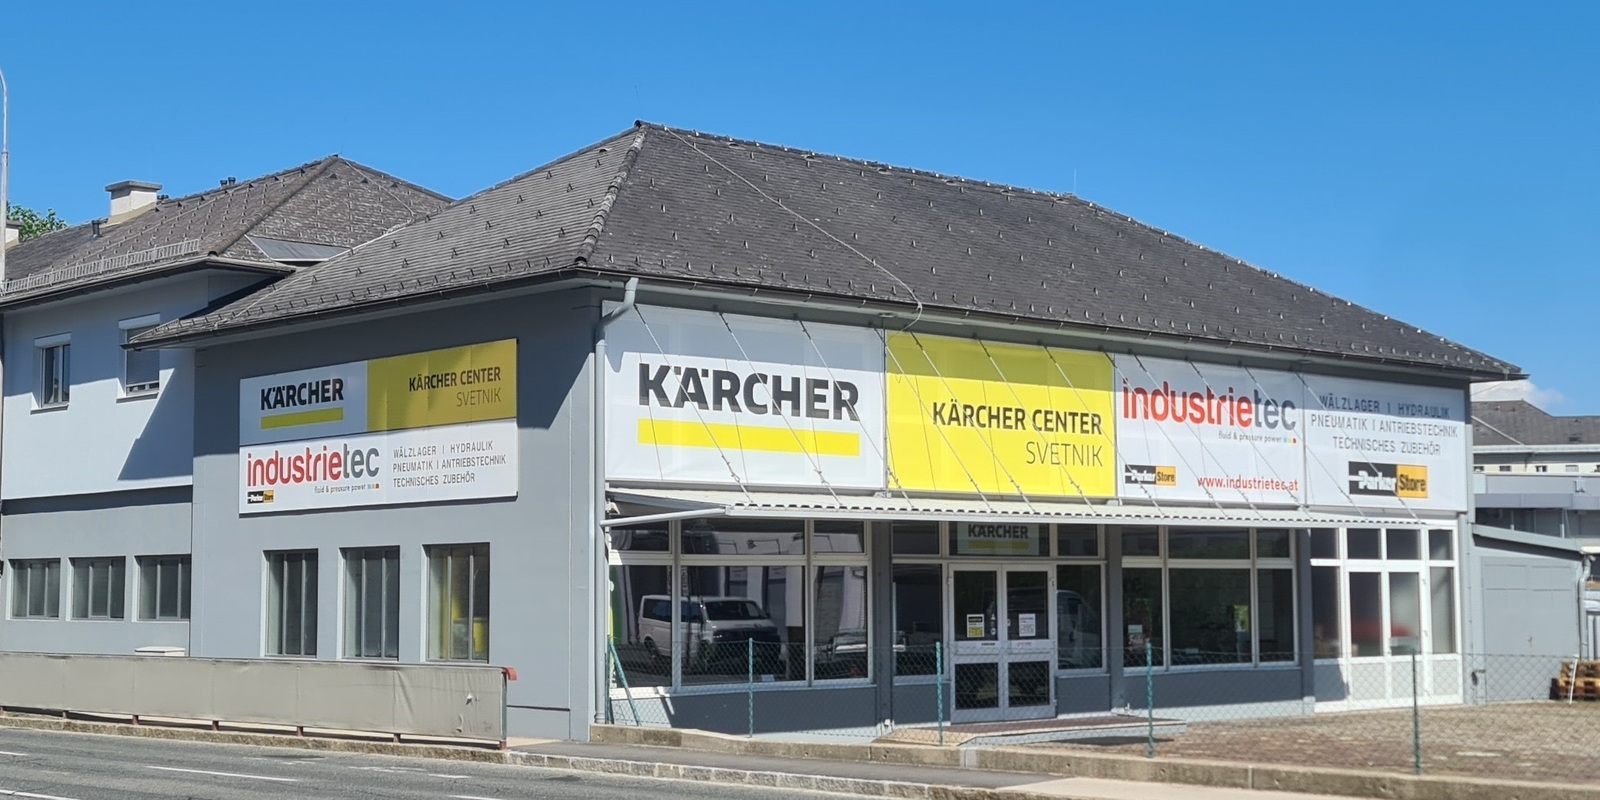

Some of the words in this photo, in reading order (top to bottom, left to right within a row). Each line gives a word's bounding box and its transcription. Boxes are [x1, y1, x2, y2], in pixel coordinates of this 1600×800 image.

[409, 372, 457, 392] KÄRCHER
[460, 366, 501, 385] CENTER
[638, 362, 860, 421] KÄRCHER
[260, 378, 344, 410] KÄRCHER
[456, 388, 501, 407] SVETNIK
[1122, 377, 1296, 431] industrietec
[1319, 393, 1380, 413] WÄLZLAGER
[1398, 403, 1450, 418] HYDRAULIK
[933, 399, 1026, 431] KÄRCHER
[1032, 409, 1102, 435] CENTER
[1311, 414, 1367, 430] PNEUMATIK
[1379, 421, 1458, 438] ANTRIEBSTECHNIK
[393, 445, 436, 458] WÄLZLAGER
[450, 441, 493, 453] HYDRAULIK
[1026, 441, 1104, 467] SVETNIK
[1333, 436, 1396, 452] TECHNISCHES
[1401, 441, 1441, 456] ZUBEHÖR
[247, 443, 380, 487] industrietec
[393, 460, 433, 473] PNEUMATIK
[441, 454, 506, 470] ANTRIEBSTECHNIK
[393, 474, 439, 488] TECHNISCHES
[442, 471, 476, 485] ZUBEHÖR
[967, 523, 1029, 539] KÄRCHER
